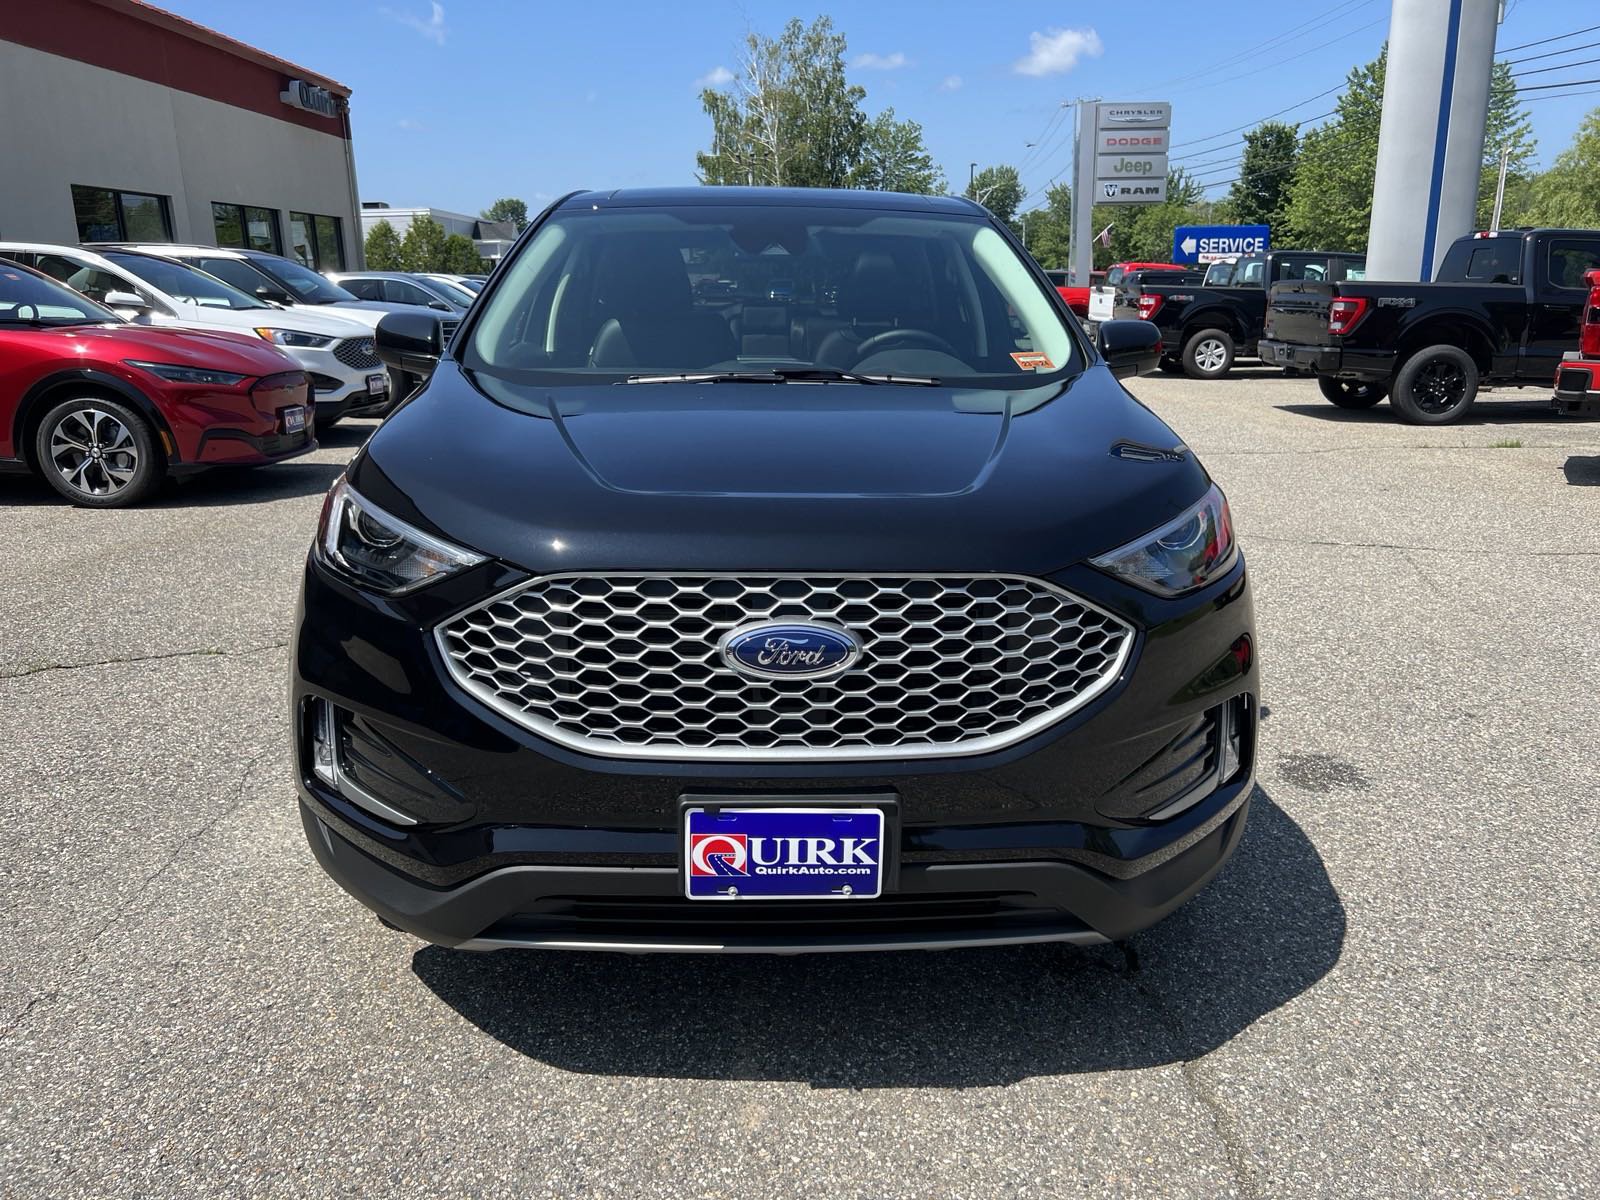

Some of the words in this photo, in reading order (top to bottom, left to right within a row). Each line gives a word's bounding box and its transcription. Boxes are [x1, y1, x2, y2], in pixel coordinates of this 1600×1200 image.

[1107, 137, 1162, 145] DODGE
[1113, 158, 1153, 175] Jeep
[1199, 238, 1264, 252] SERVICE
[757, 637, 826, 665] Ford
[691, 834, 878, 876] QUIRK
[755, 866, 871, 875] QuirkAuto.com
